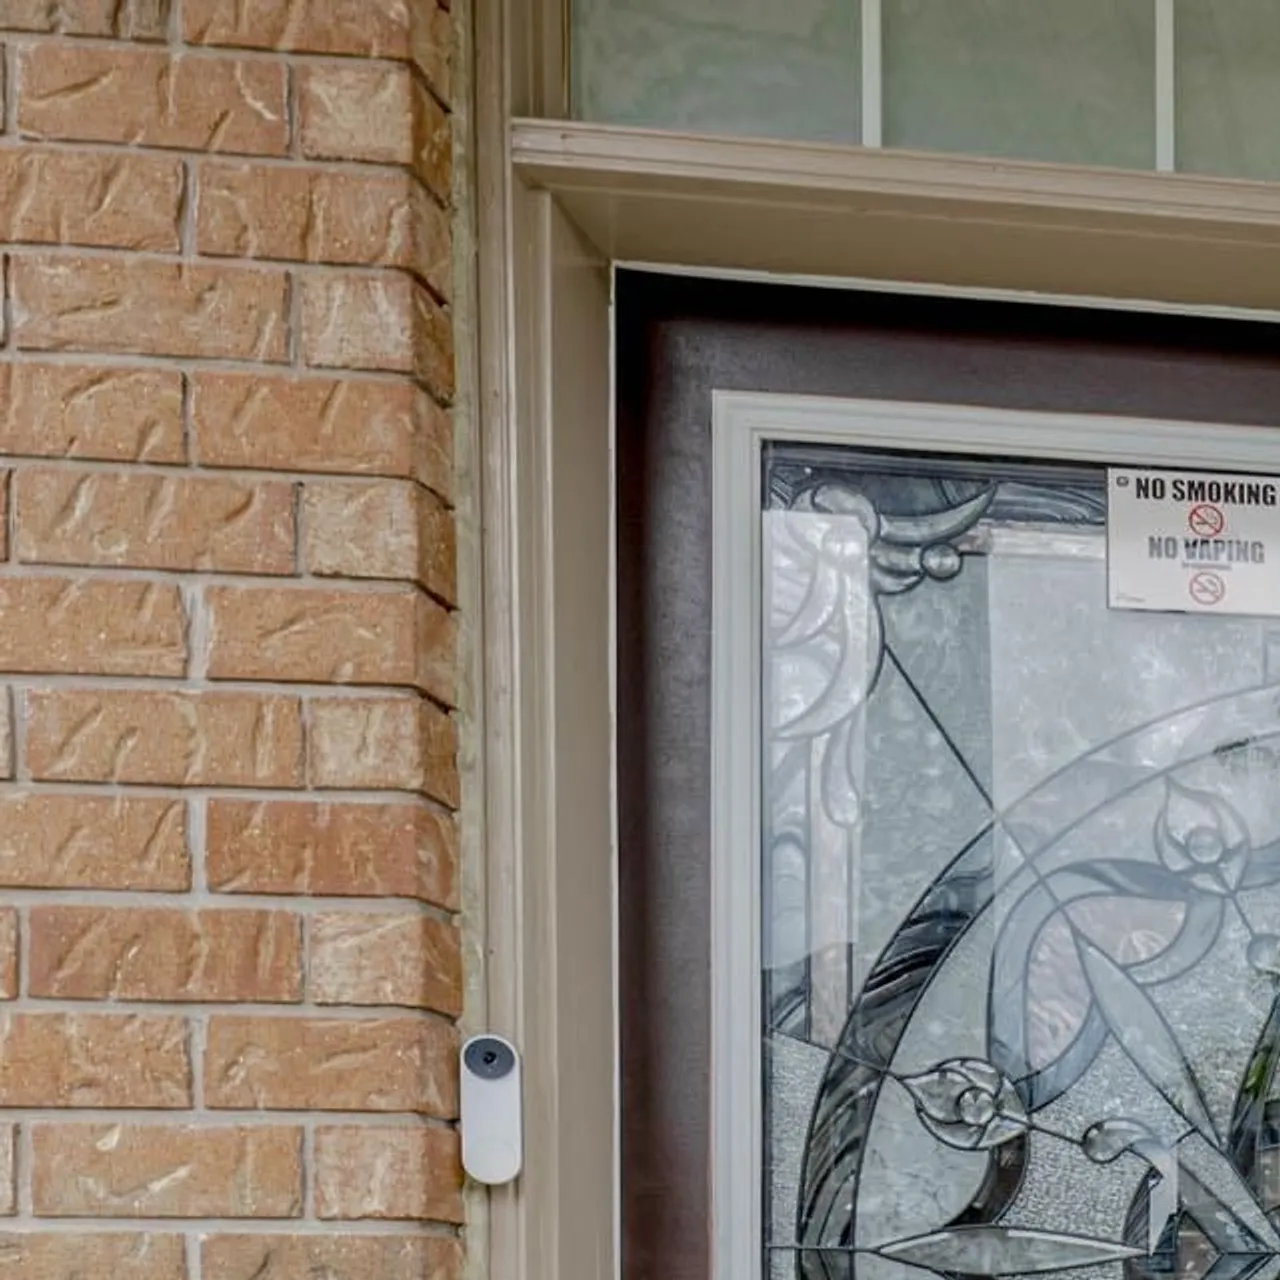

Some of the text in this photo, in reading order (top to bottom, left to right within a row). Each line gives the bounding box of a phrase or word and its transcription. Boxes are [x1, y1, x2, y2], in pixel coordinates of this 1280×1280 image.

[1135, 477, 1277, 506] NO SMOKING
[1148, 536, 1265, 564] NO VAPING
